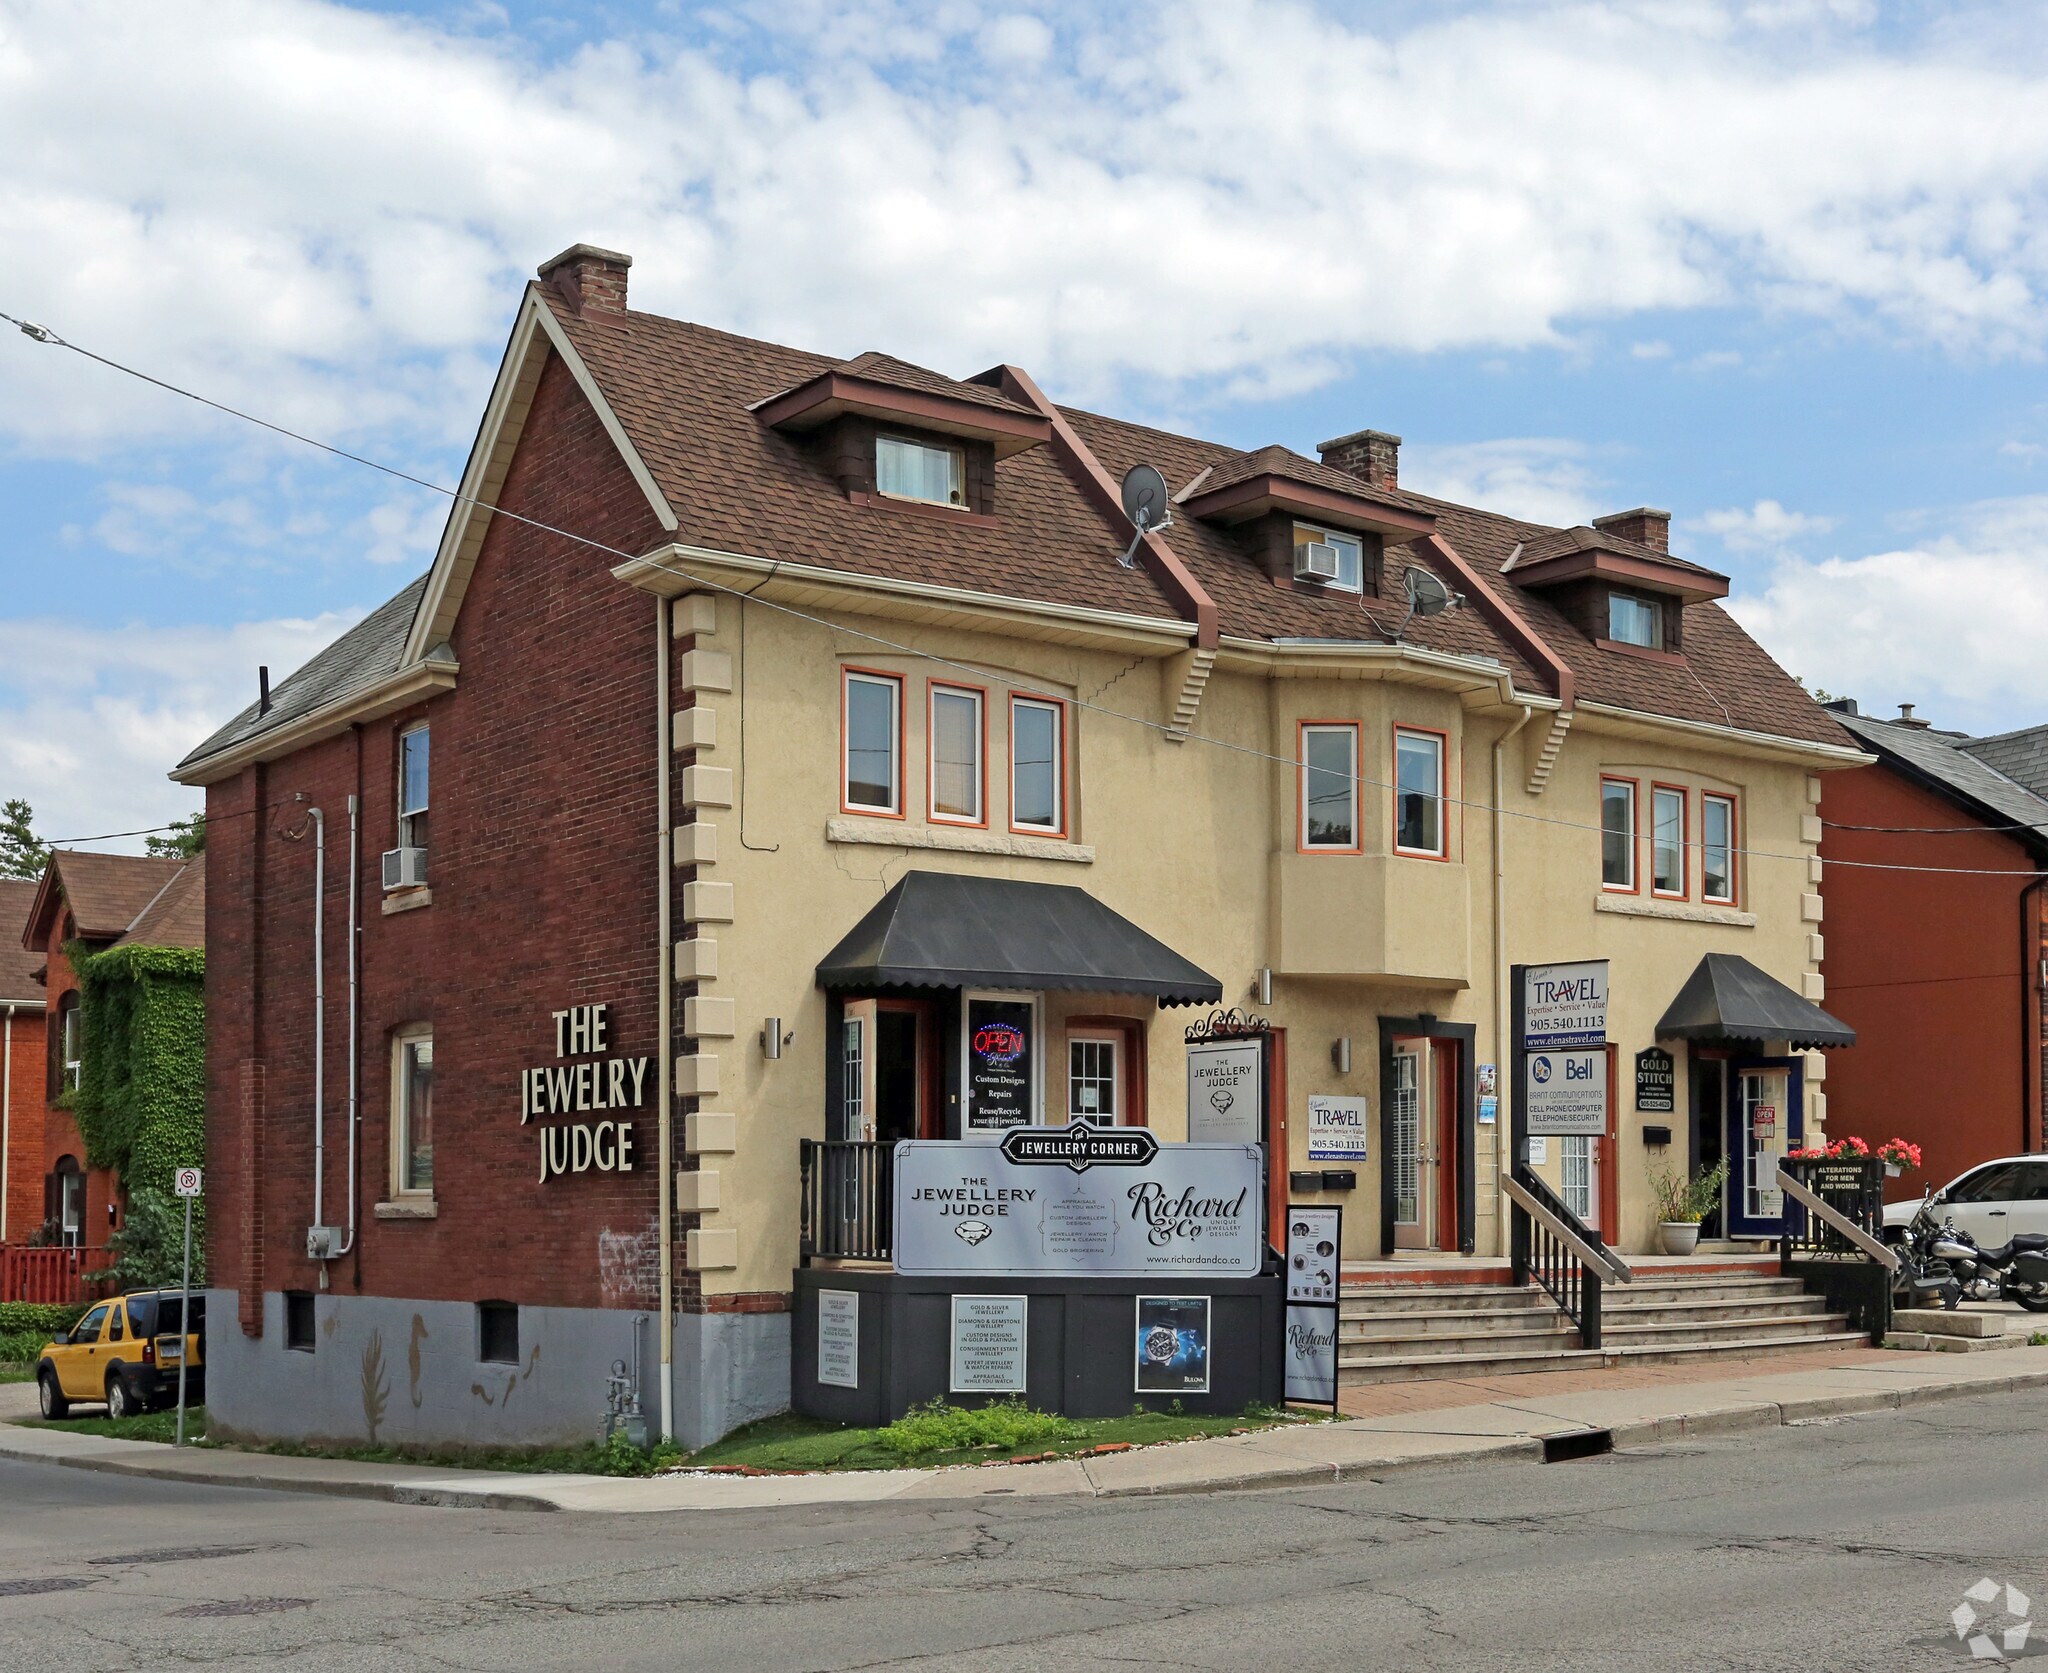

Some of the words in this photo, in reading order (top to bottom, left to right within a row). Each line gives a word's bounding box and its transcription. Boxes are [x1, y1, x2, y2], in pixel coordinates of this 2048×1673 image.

[1534, 979, 1600, 1003] TRAVEL
[1528, 1006, 1552, 1016] Expertise
[1588, 1001, 1605, 1009] Value
[1531, 1016, 1604, 1031] 905.540.1113
[552, 1004, 606, 1058] THE
[974, 1032, 1023, 1052] OPEN
[1528, 1034, 1604, 1046] www.elenastravel.com
[1566, 1058, 1592, 1080] Bell
[1641, 1059, 1669, 1070] GOLD
[1195, 1066, 1252, 1077] JEWELLERY
[975, 1075, 999, 1083] Custom
[1001, 1076, 1025, 1086] Designs
[1207, 1078, 1238, 1087] JUDGE
[1638, 1072, 1672, 1084] STITCH
[521, 1057, 648, 1125] JEWELRY
[988, 1090, 1012, 1099] Repairs
[1550, 1090, 1602, 1099] COMMUNICATIONS
[979, 1108, 1021, 1116] Reuse/Recycle
[1315, 1110, 1362, 1126] TRAVEL
[973, 1118, 987, 1126] your
[999, 1117, 1026, 1126] jewellery
[1075, 1132, 1084, 1140] THE
[1021, 1142, 1088, 1154] JEWELLERY
[1091, 1143, 1138, 1154] CORNER
[1312, 1140, 1365, 1149] 905.540.1113
[539, 1121, 632, 1184] JUDGE
[1310, 1152, 1365, 1160] www.elenastravel.com
[962, 1178, 988, 1186] THE
[912, 1188, 1036, 1201] JEWELLERY
[1127, 1182, 1247, 1225] Richard
[940, 1204, 1008, 1216] JUDGE
[1147, 1255, 1240, 1264] www.richardandco.ca
[1288, 1325, 1335, 1349] Richard
